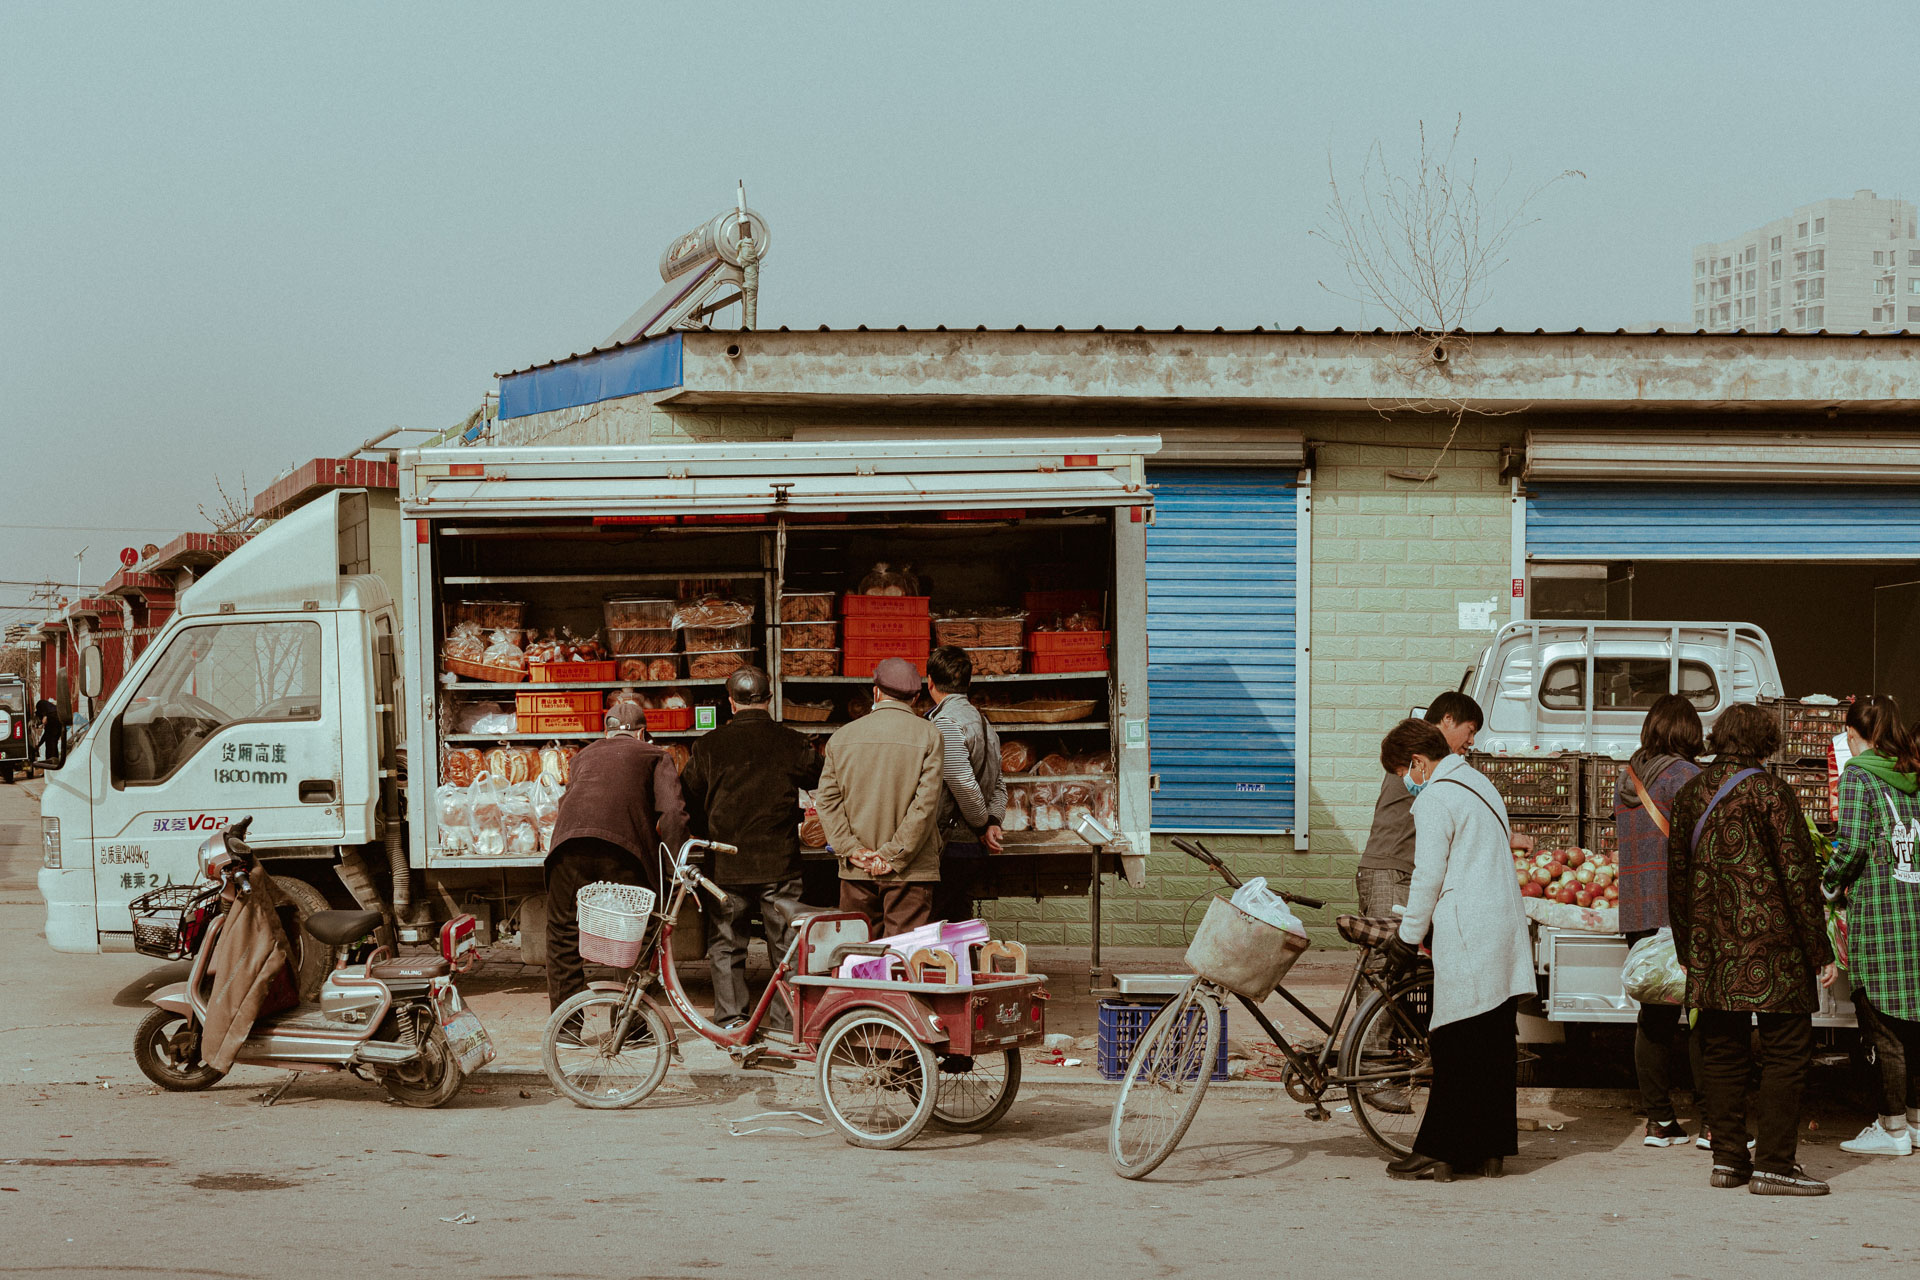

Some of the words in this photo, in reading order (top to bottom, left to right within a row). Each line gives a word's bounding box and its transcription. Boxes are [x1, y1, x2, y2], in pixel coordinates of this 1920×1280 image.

[222, 742, 287, 763] 货厢高度
[214, 768, 288, 784] 1800mm
[100, 845, 150, 869] 总质量3499kg
